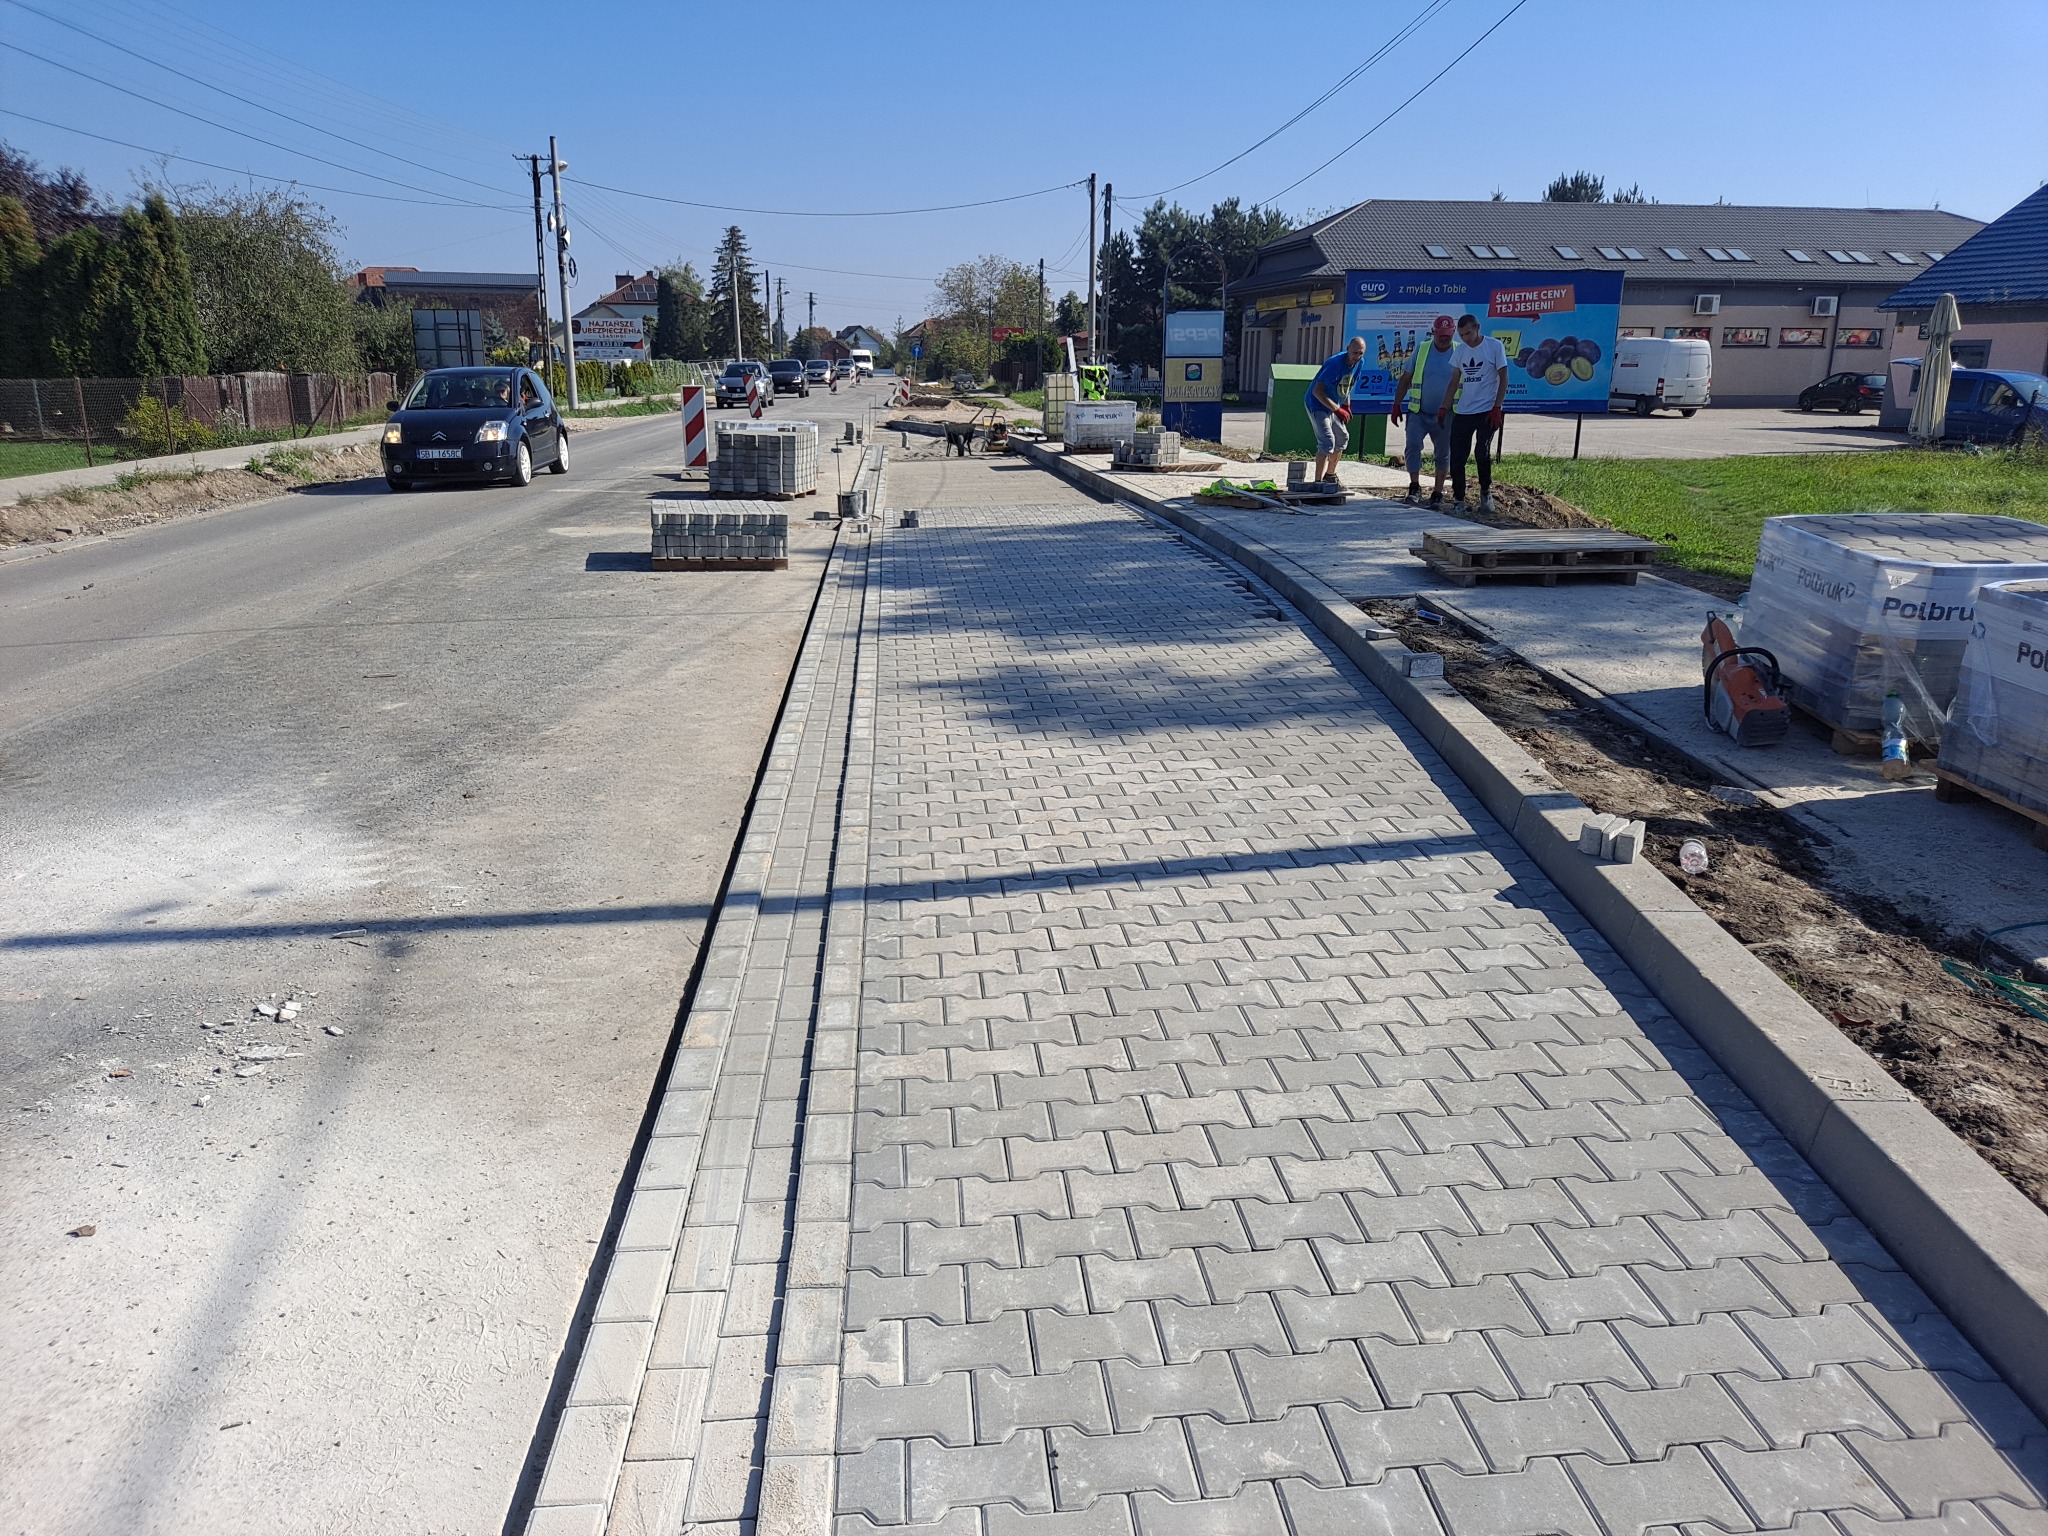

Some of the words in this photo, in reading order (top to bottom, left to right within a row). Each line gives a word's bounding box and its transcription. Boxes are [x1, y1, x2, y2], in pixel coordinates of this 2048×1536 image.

[1360, 283, 1385, 292] euro
[1406, 283, 1432, 295] myślą
[1442, 284, 1467, 293] Tobie
[1495, 291, 1539, 303] ŚWIETNE
[1540, 289, 1567, 299] CENY
[1495, 304, 1513, 313] TEJ
[1515, 300, 1555, 312] JESIENI!
[588, 320, 635, 328] NAJTAŃSZE
[1501, 336, 1512, 344] 79
[1360, 375, 1370, 389] 2
[1370, 374, 1383, 383] 29
[1166, 385, 1221, 398] DELIKATESY
[1797, 567, 1845, 602] Polbruk
